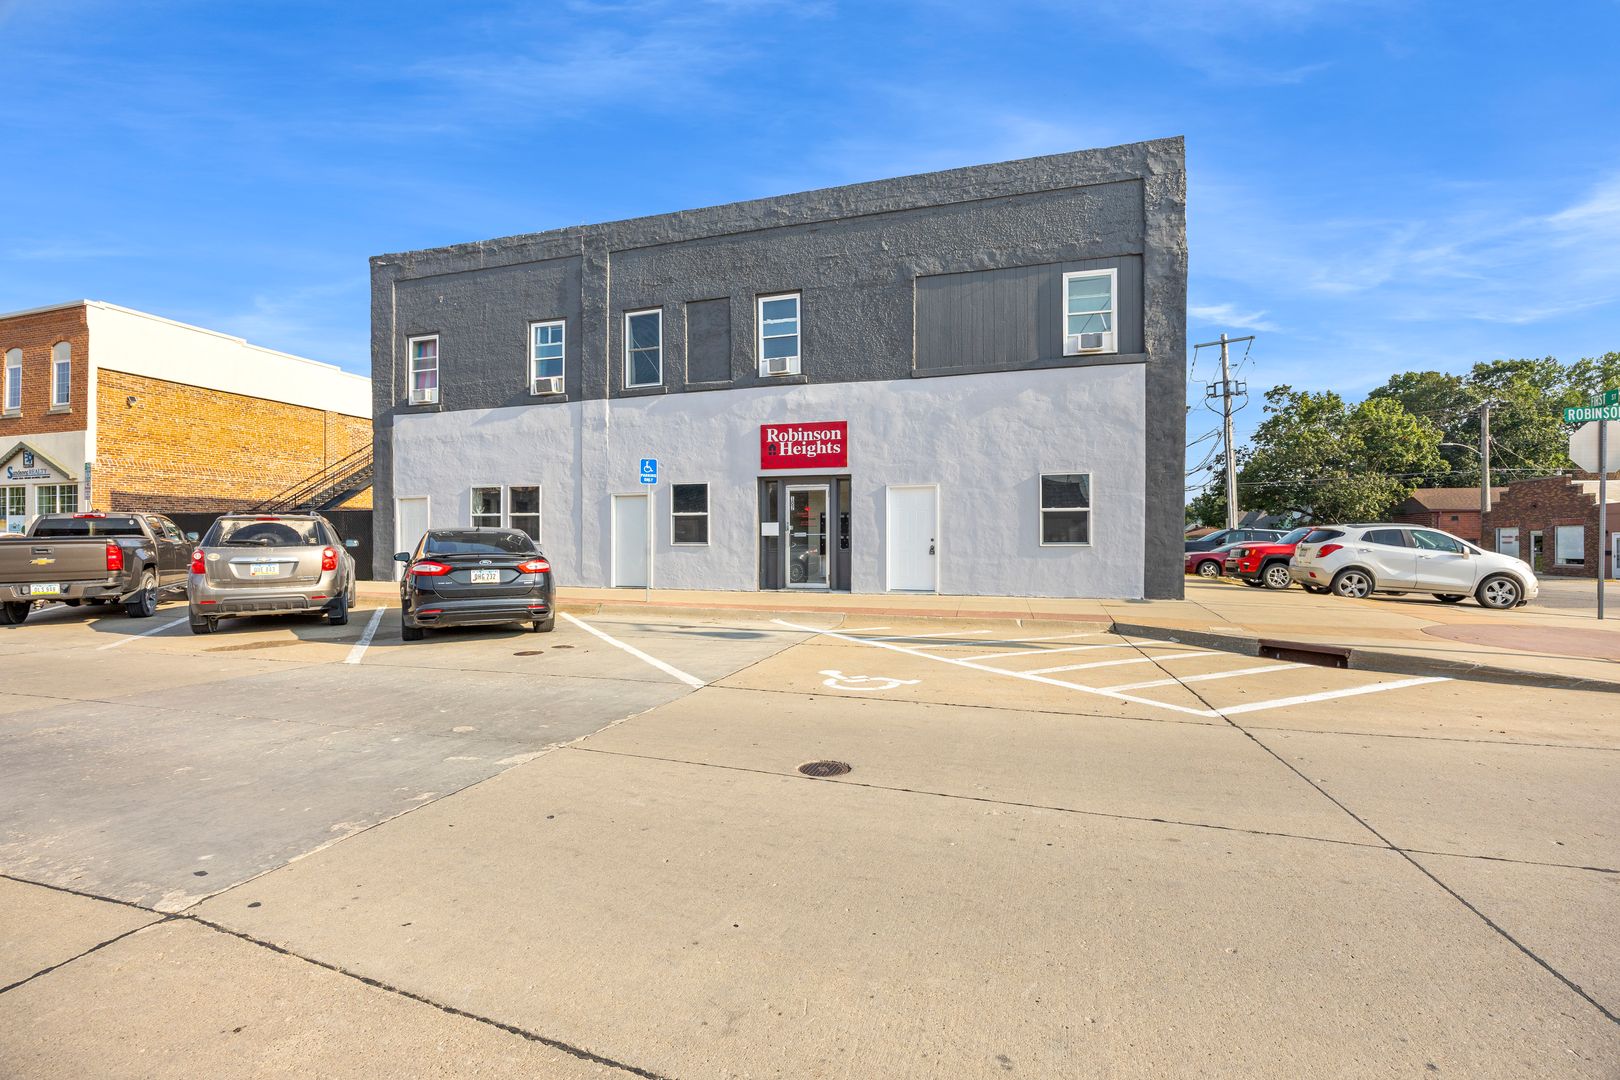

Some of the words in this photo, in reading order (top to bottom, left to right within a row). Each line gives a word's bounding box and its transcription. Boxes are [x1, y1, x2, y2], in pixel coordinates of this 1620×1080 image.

[1590, 394, 1606, 407] FIRST
[766, 427, 841, 443] Robinson
[779, 441, 841, 457] Heights
